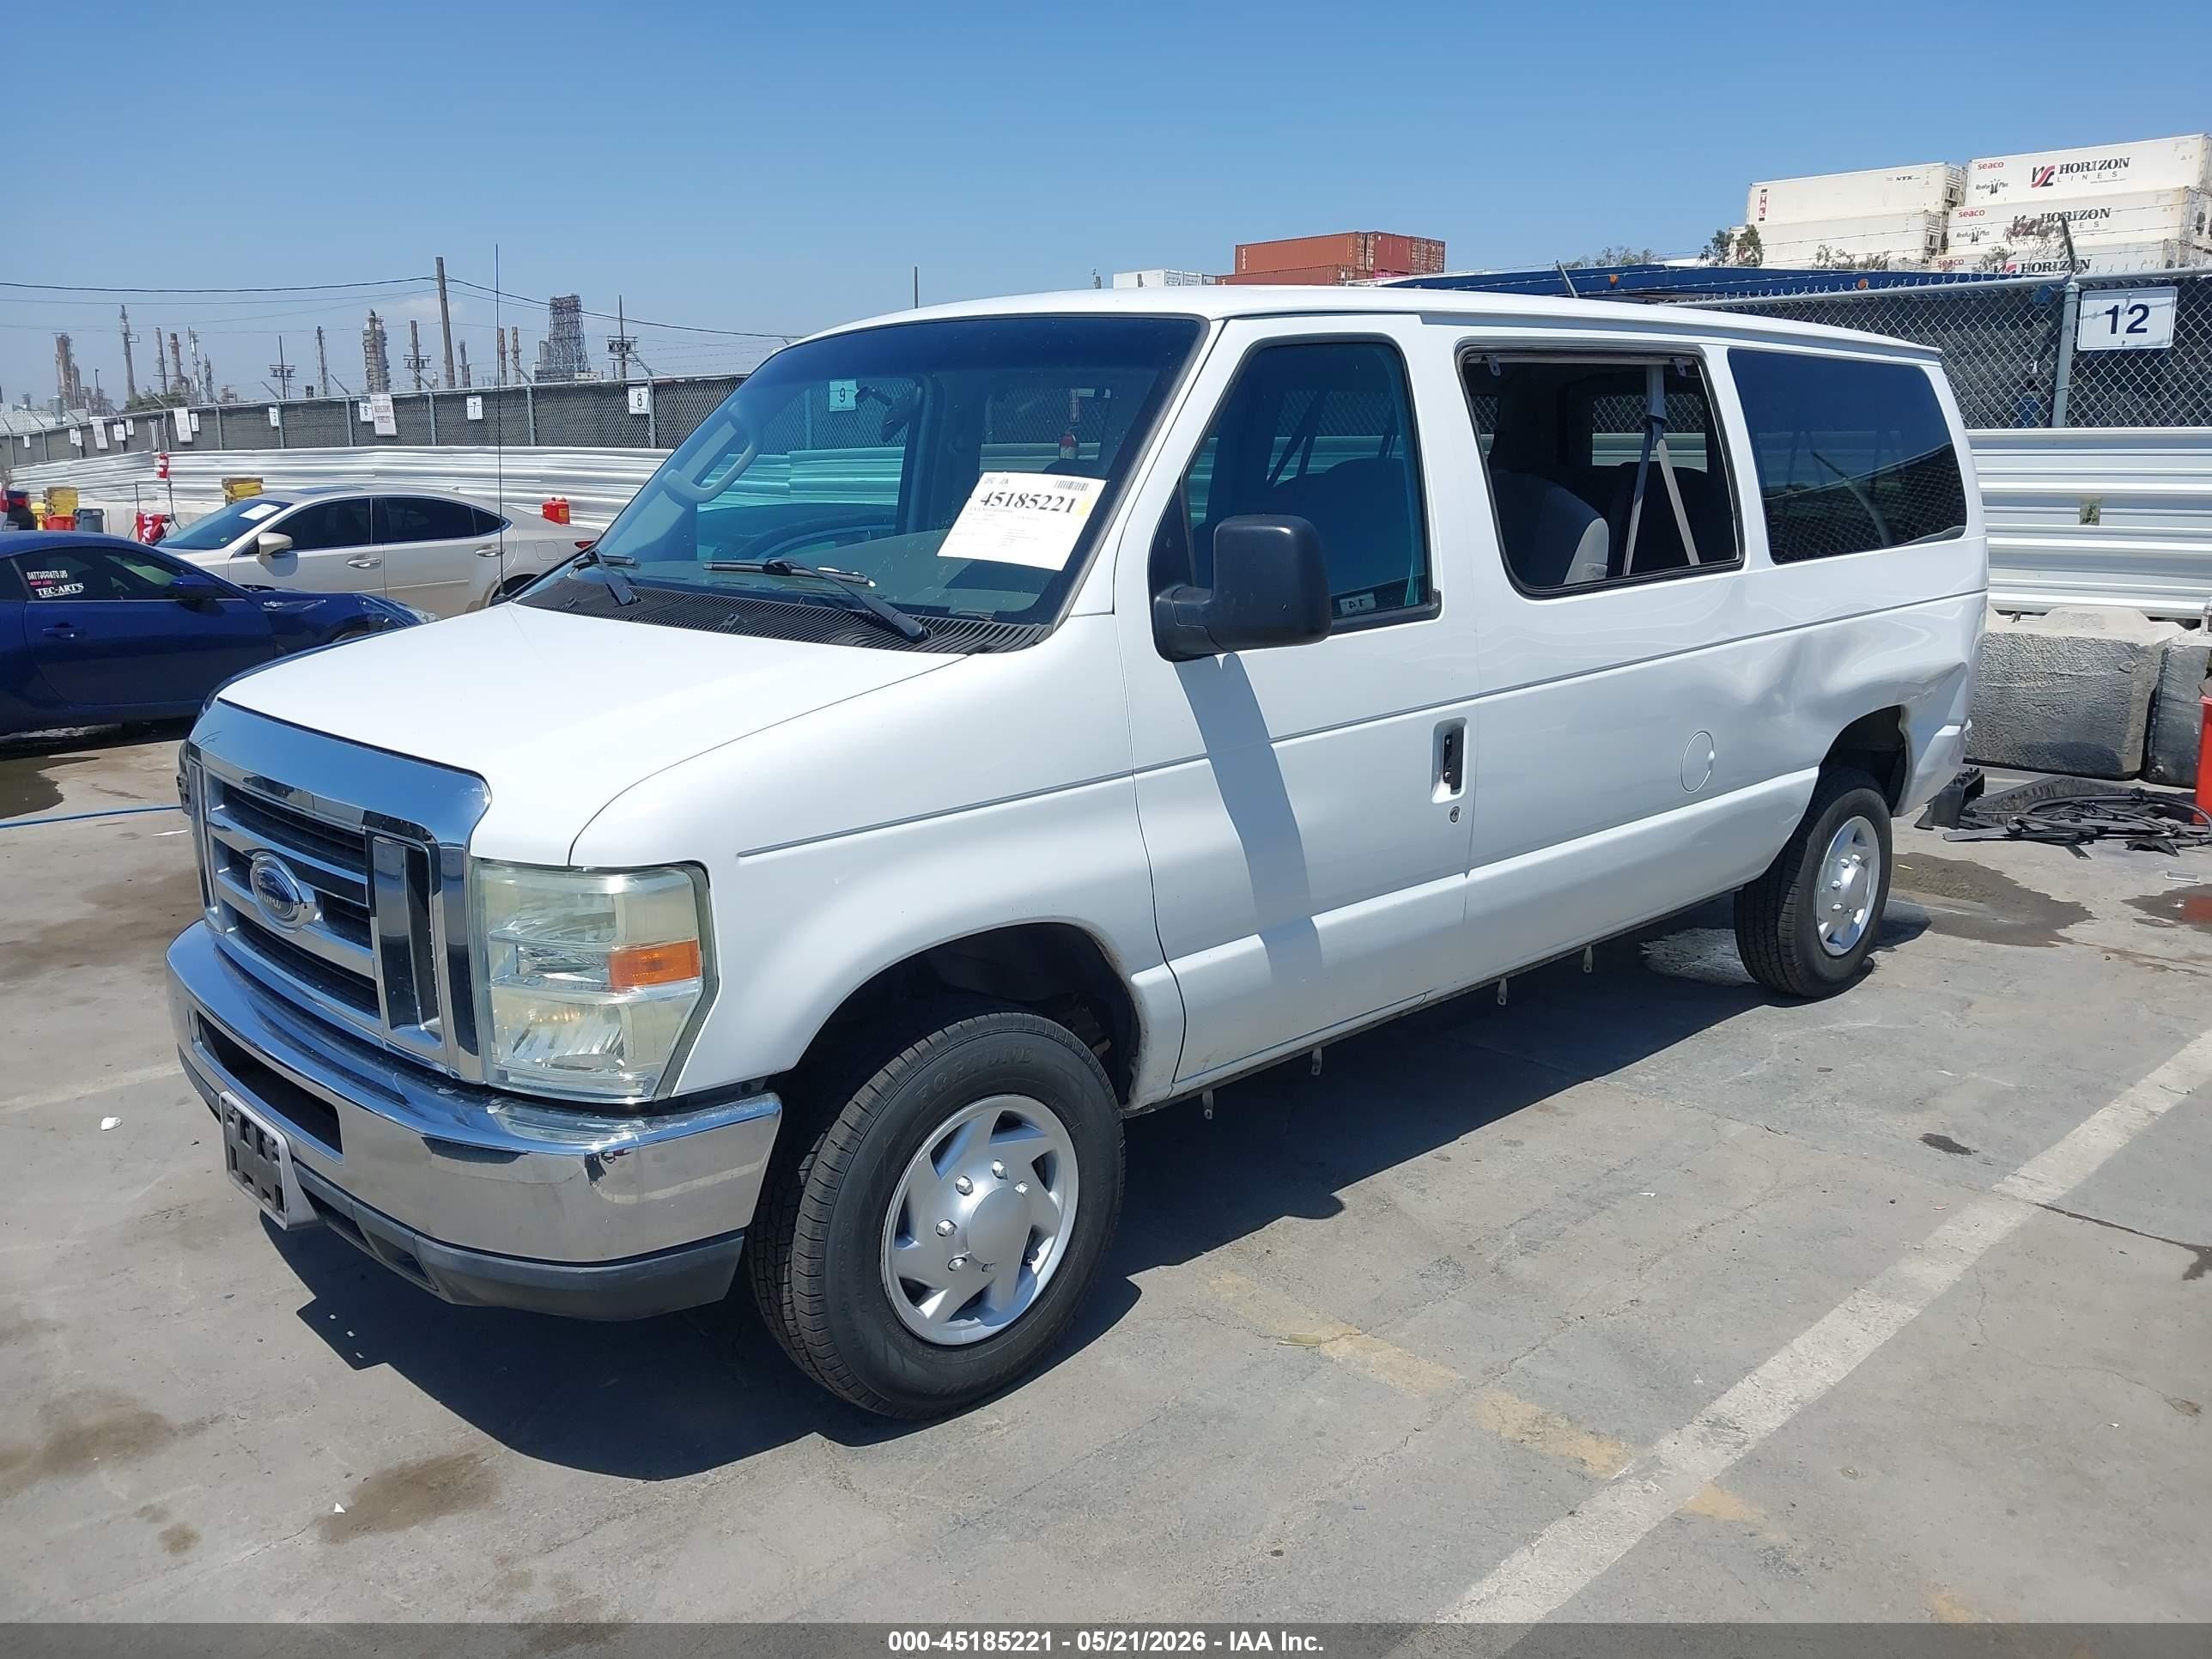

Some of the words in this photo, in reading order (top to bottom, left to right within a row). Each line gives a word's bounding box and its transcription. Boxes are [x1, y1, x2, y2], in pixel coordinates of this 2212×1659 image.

[1978, 161, 2004, 170] seaco
[2059, 157, 2131, 174] HORIZON
[2057, 171, 2118, 183] LINES
[1958, 209, 1985, 218] seaco
[2039, 208, 2112, 224] HORIZON
[2020, 258, 2092, 273] HORIZN
[2106, 303, 2149, 335] 12
[636, 392, 643, 407] 8
[839, 386, 846, 403] 9
[471, 401, 477, 415] 7
[980, 491, 1076, 514] 45185221
